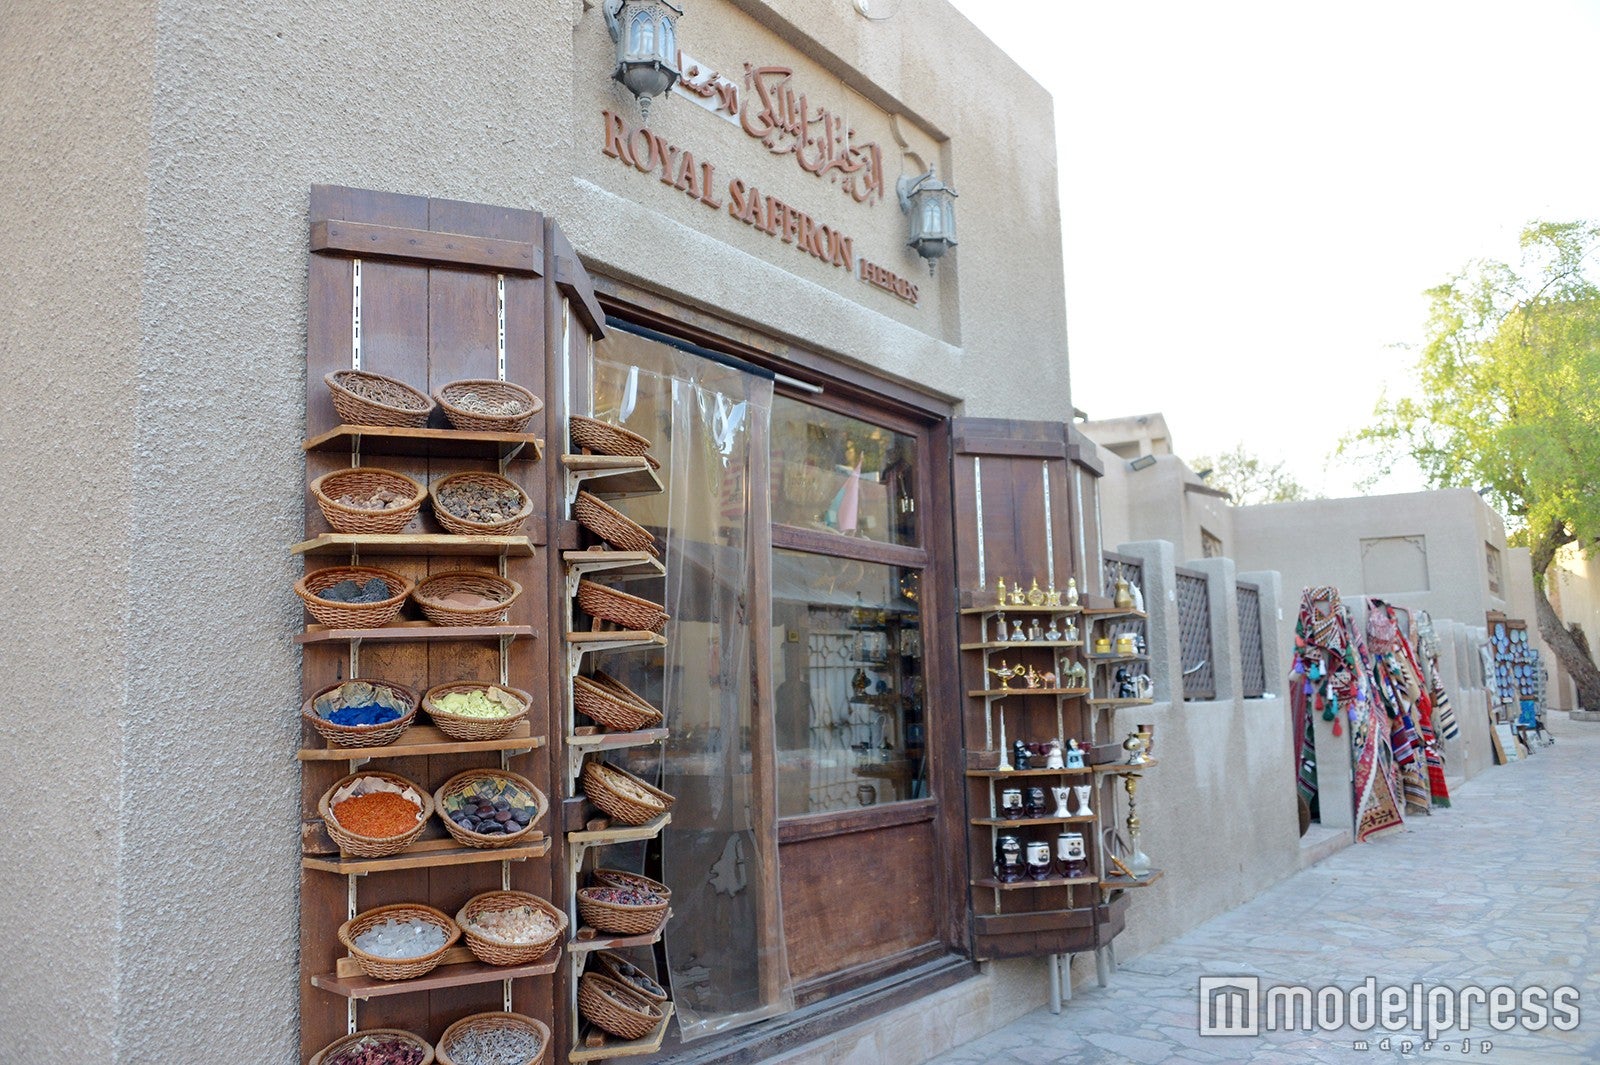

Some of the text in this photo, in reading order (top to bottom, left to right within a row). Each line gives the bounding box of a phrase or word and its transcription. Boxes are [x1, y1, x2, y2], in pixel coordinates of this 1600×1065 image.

[602, 110, 919, 304] ROYAL SAFFRON HERBS
